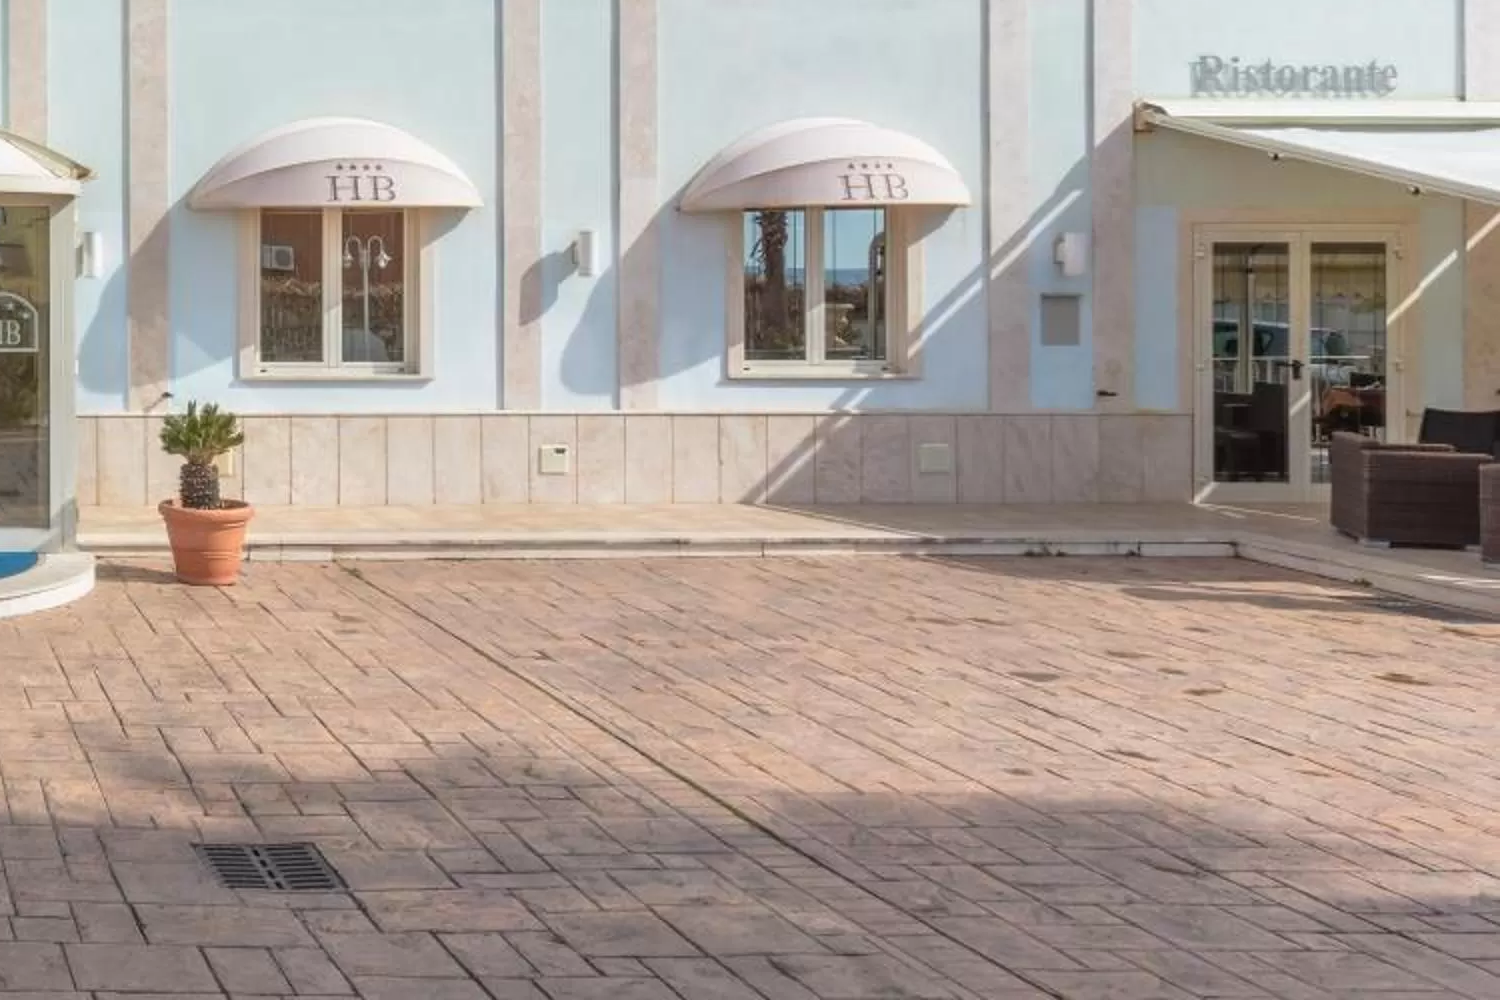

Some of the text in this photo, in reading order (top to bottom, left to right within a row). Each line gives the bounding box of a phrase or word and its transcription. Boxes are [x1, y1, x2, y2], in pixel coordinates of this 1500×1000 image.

[1197, 55, 1398, 95] Ristorante
[324, 175, 397, 202] HB
[837, 173, 909, 200] HB
